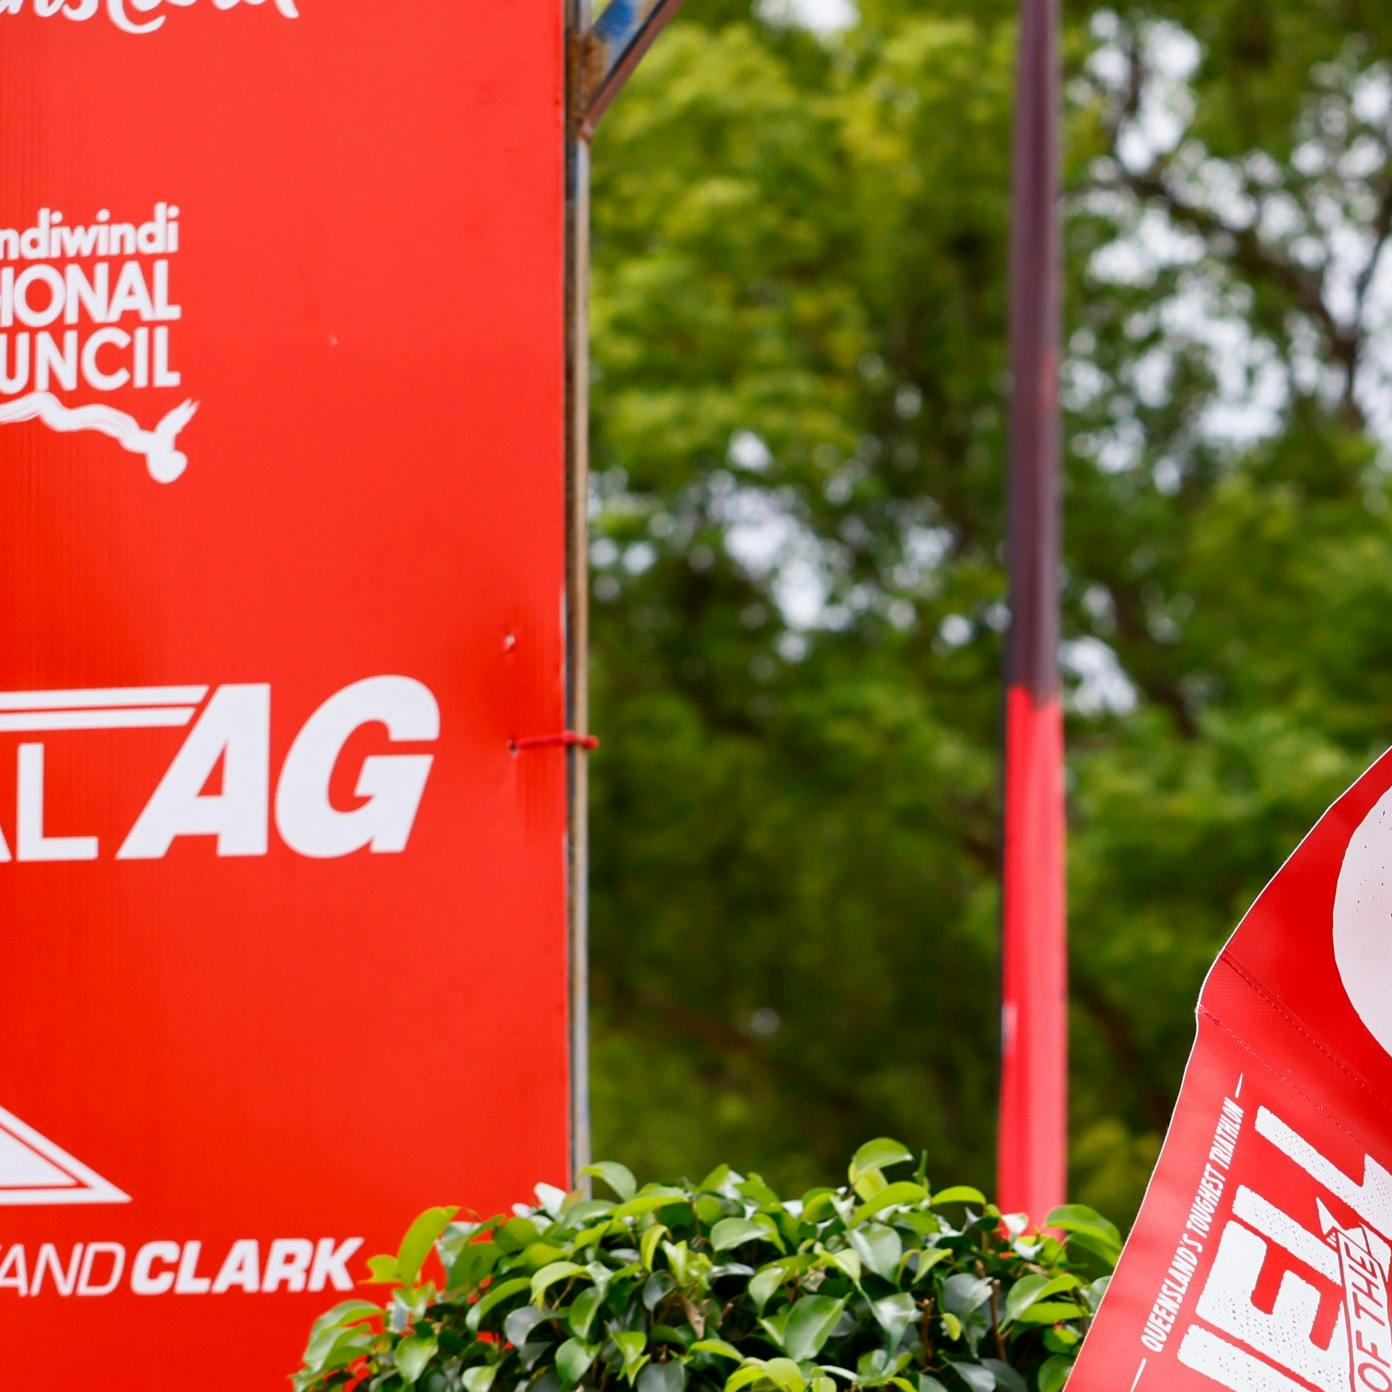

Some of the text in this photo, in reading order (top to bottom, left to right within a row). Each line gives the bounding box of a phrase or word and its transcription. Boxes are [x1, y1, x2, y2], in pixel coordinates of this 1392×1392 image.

[115, 675, 441, 860] AG
[131, 1237, 364, 1295] CLARK
[1141, 1096, 1244, 1353] QUEENSLAND'S TOUGHEST TRIATHLON
[1344, 1241, 1386, 1327] THE
